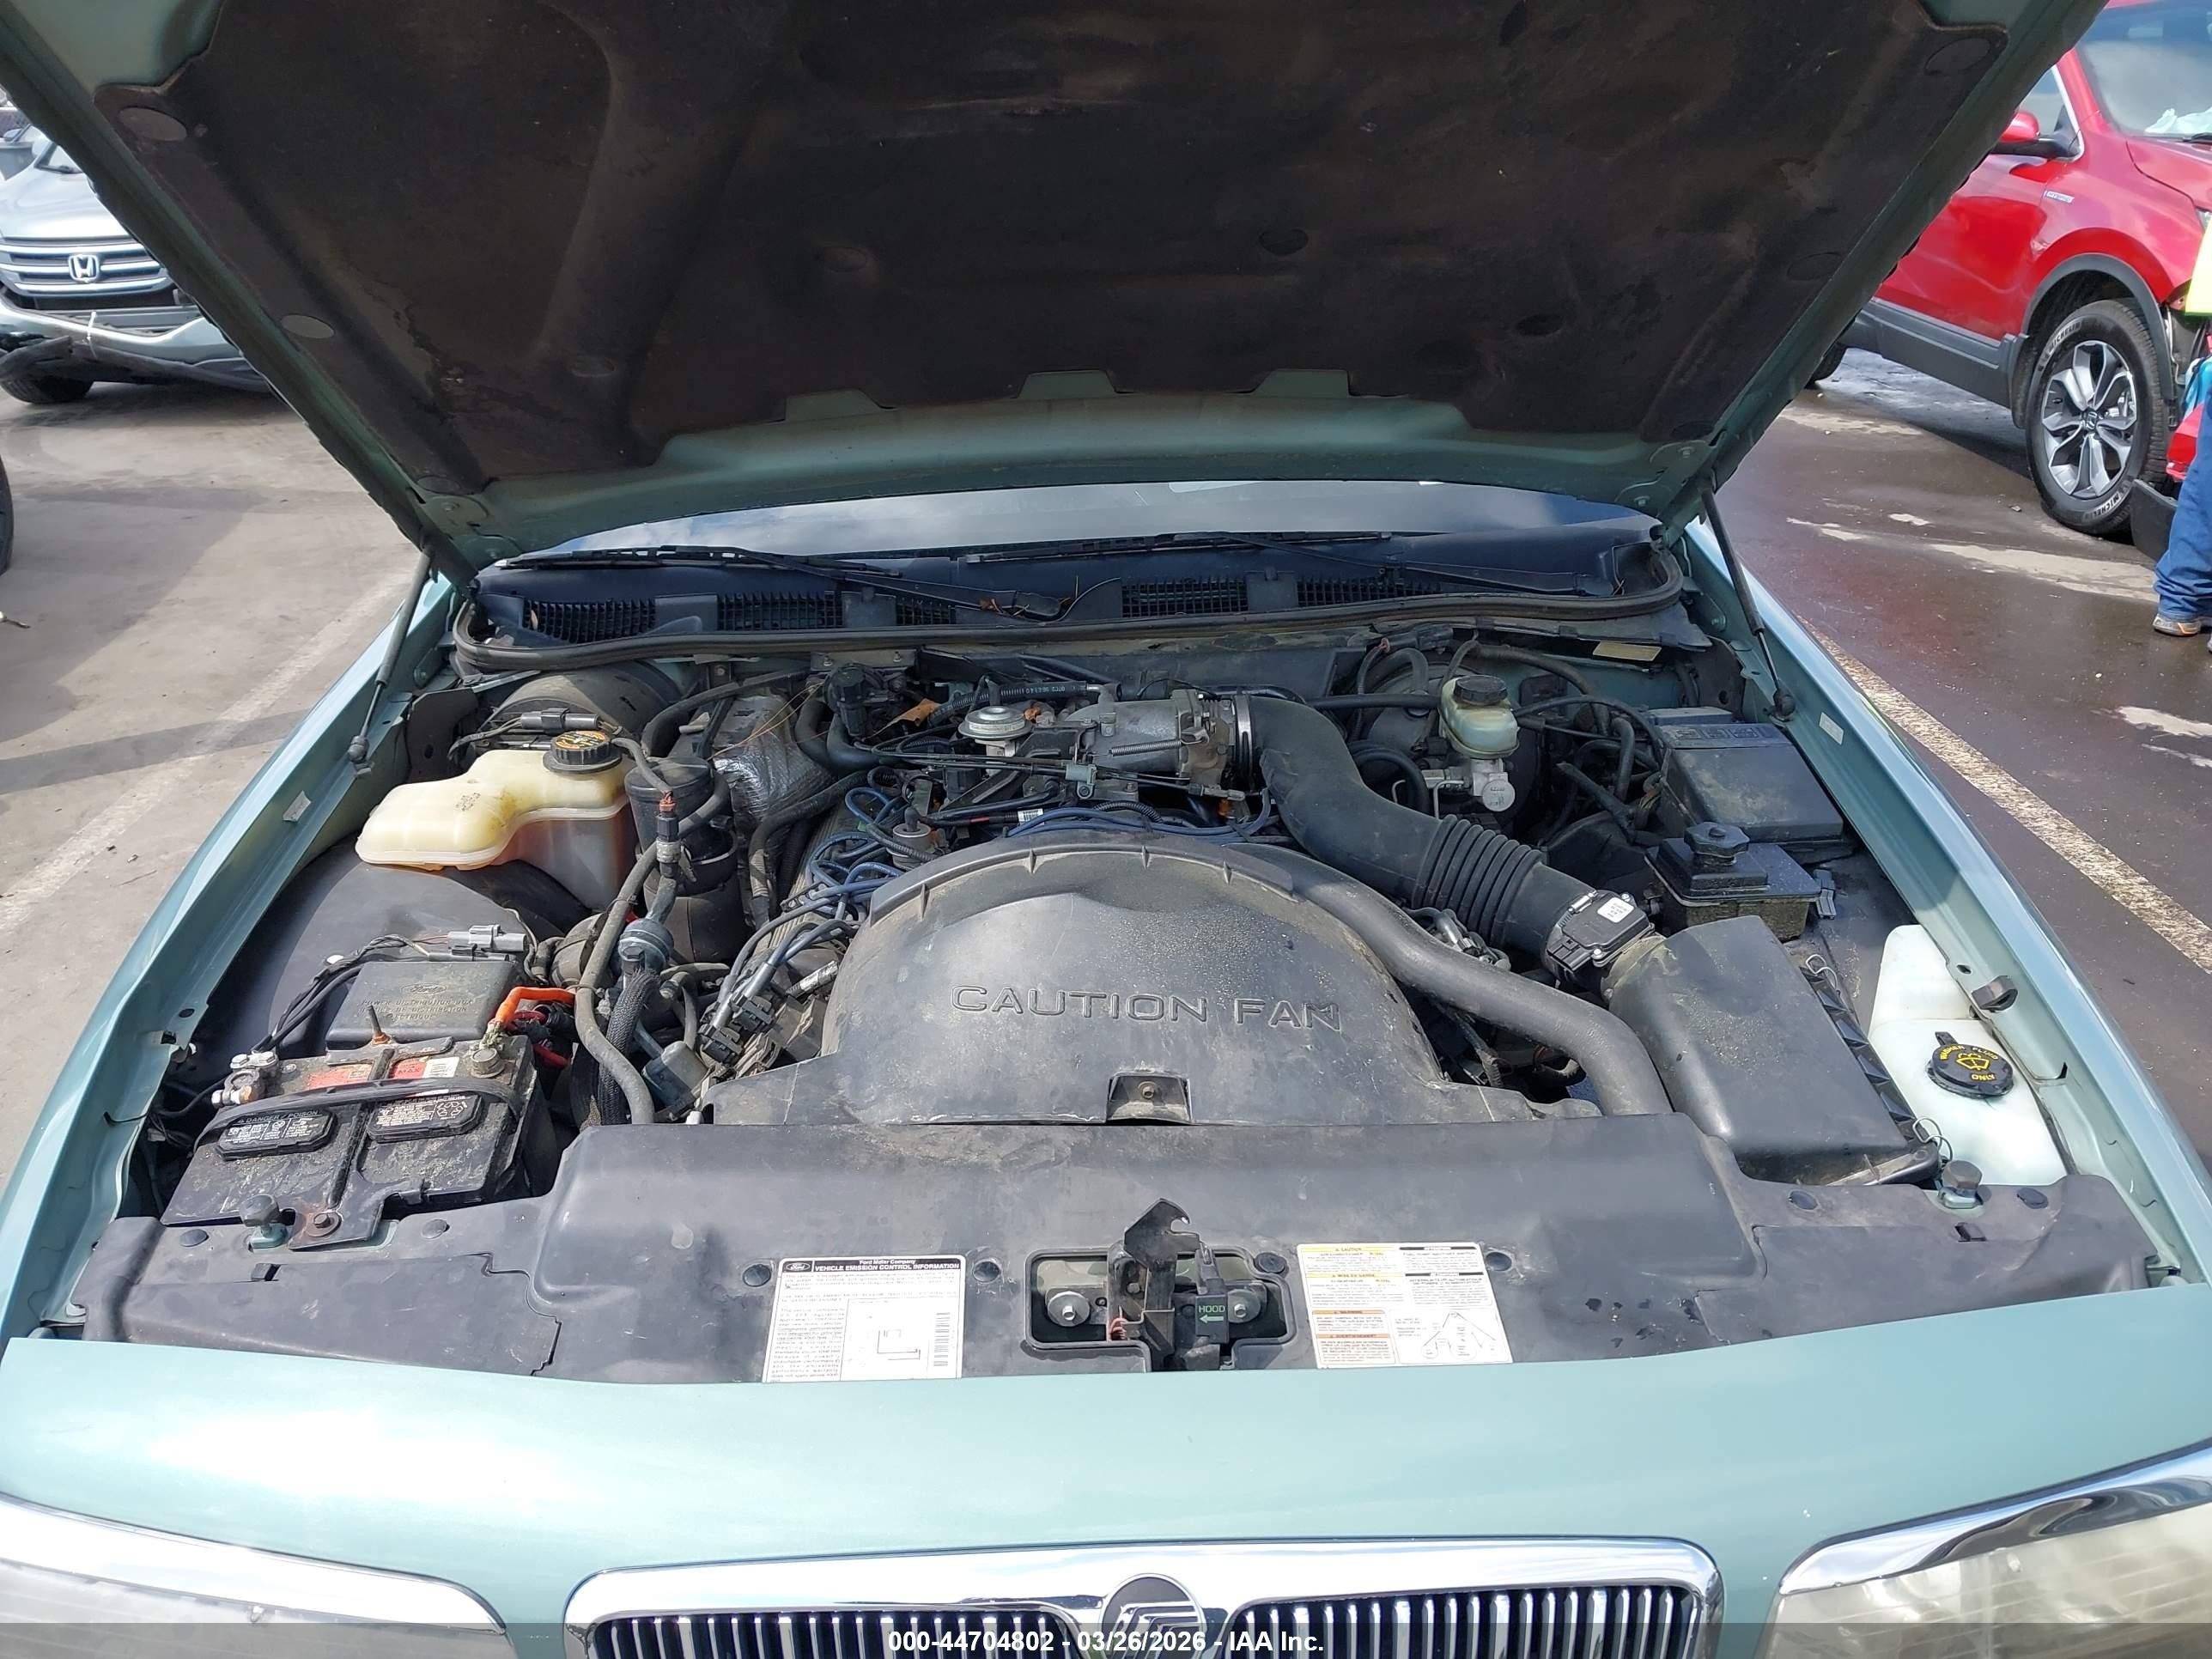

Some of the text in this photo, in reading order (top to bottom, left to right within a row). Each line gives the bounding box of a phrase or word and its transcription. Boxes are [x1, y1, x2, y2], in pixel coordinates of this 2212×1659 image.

[951, 985, 1341, 1030] CAUTION FAN
[1939, 1044, 2000, 1060] WASHER FLUID
[246, 1115, 279, 1123] DANGER
[288, 1110, 319, 1119] POISON
[1198, 1304, 1225, 1313] HOOD
